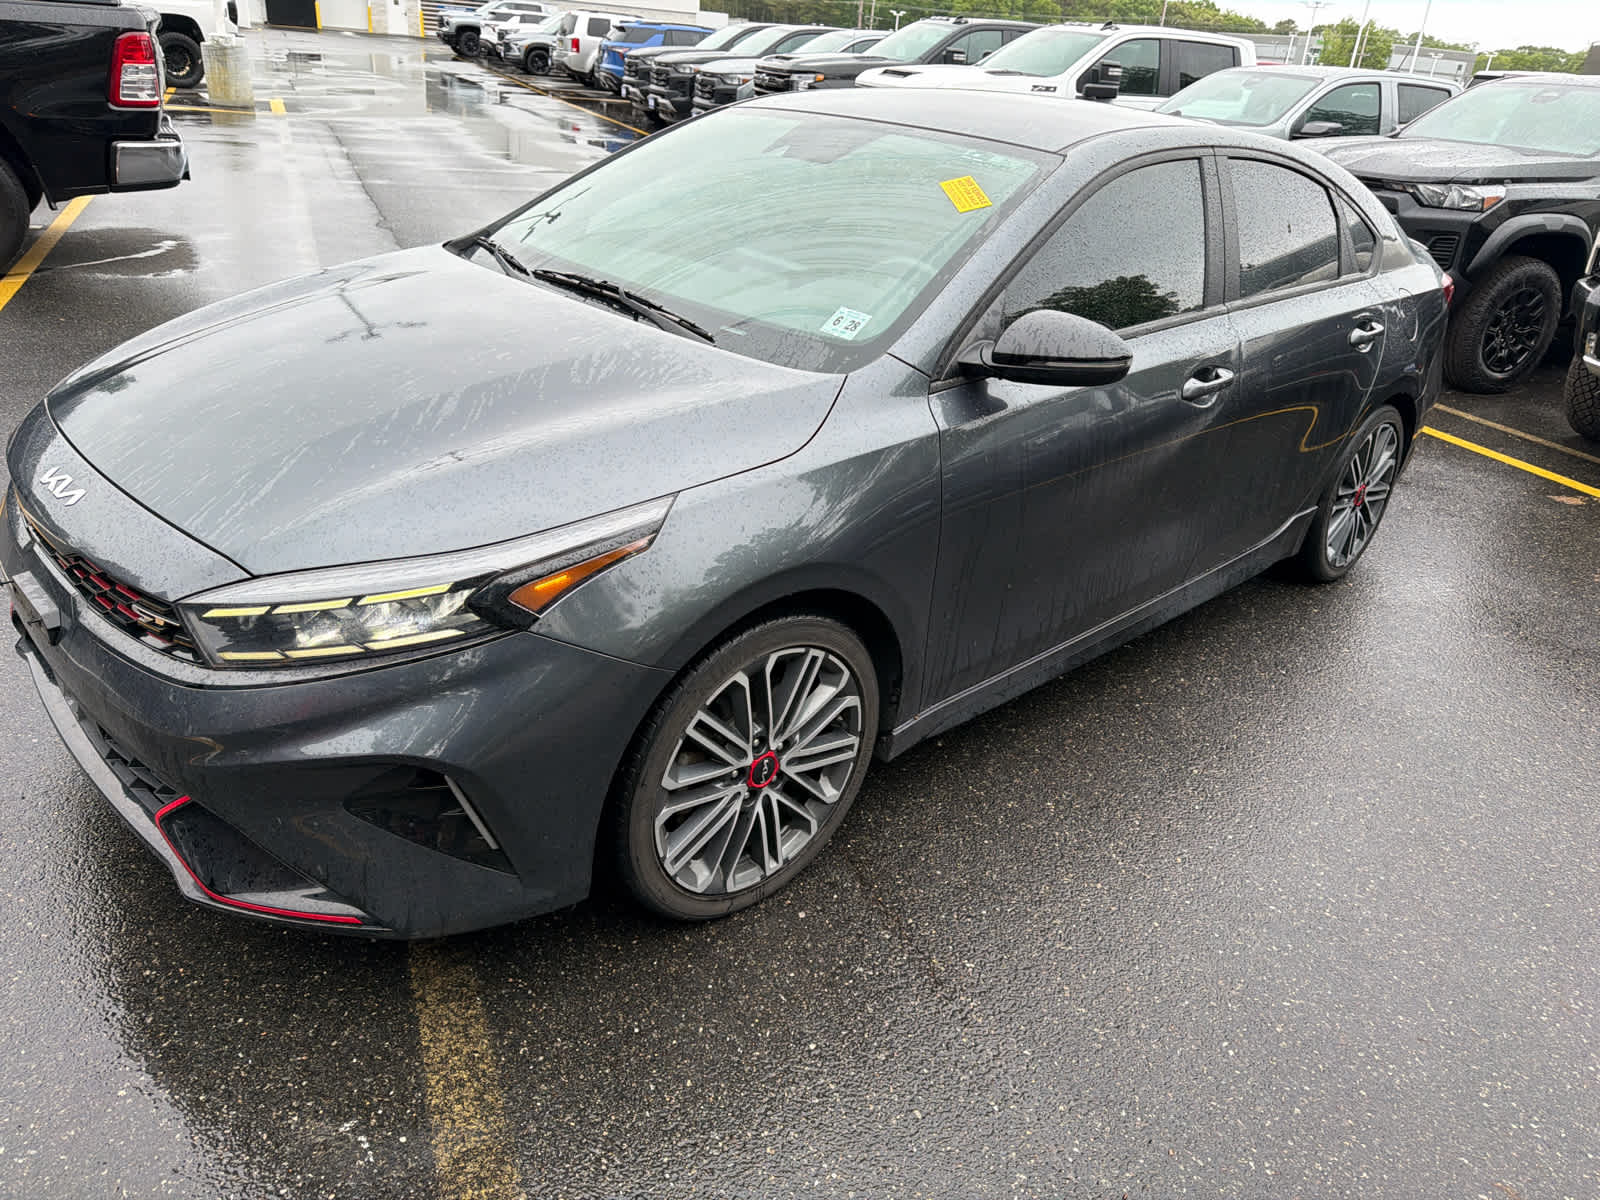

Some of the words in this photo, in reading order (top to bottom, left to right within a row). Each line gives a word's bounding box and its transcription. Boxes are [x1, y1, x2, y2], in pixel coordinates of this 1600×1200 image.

[832, 315, 844, 326] 6
[844, 319, 861, 332] 28
[40, 466, 88, 507] KIA
